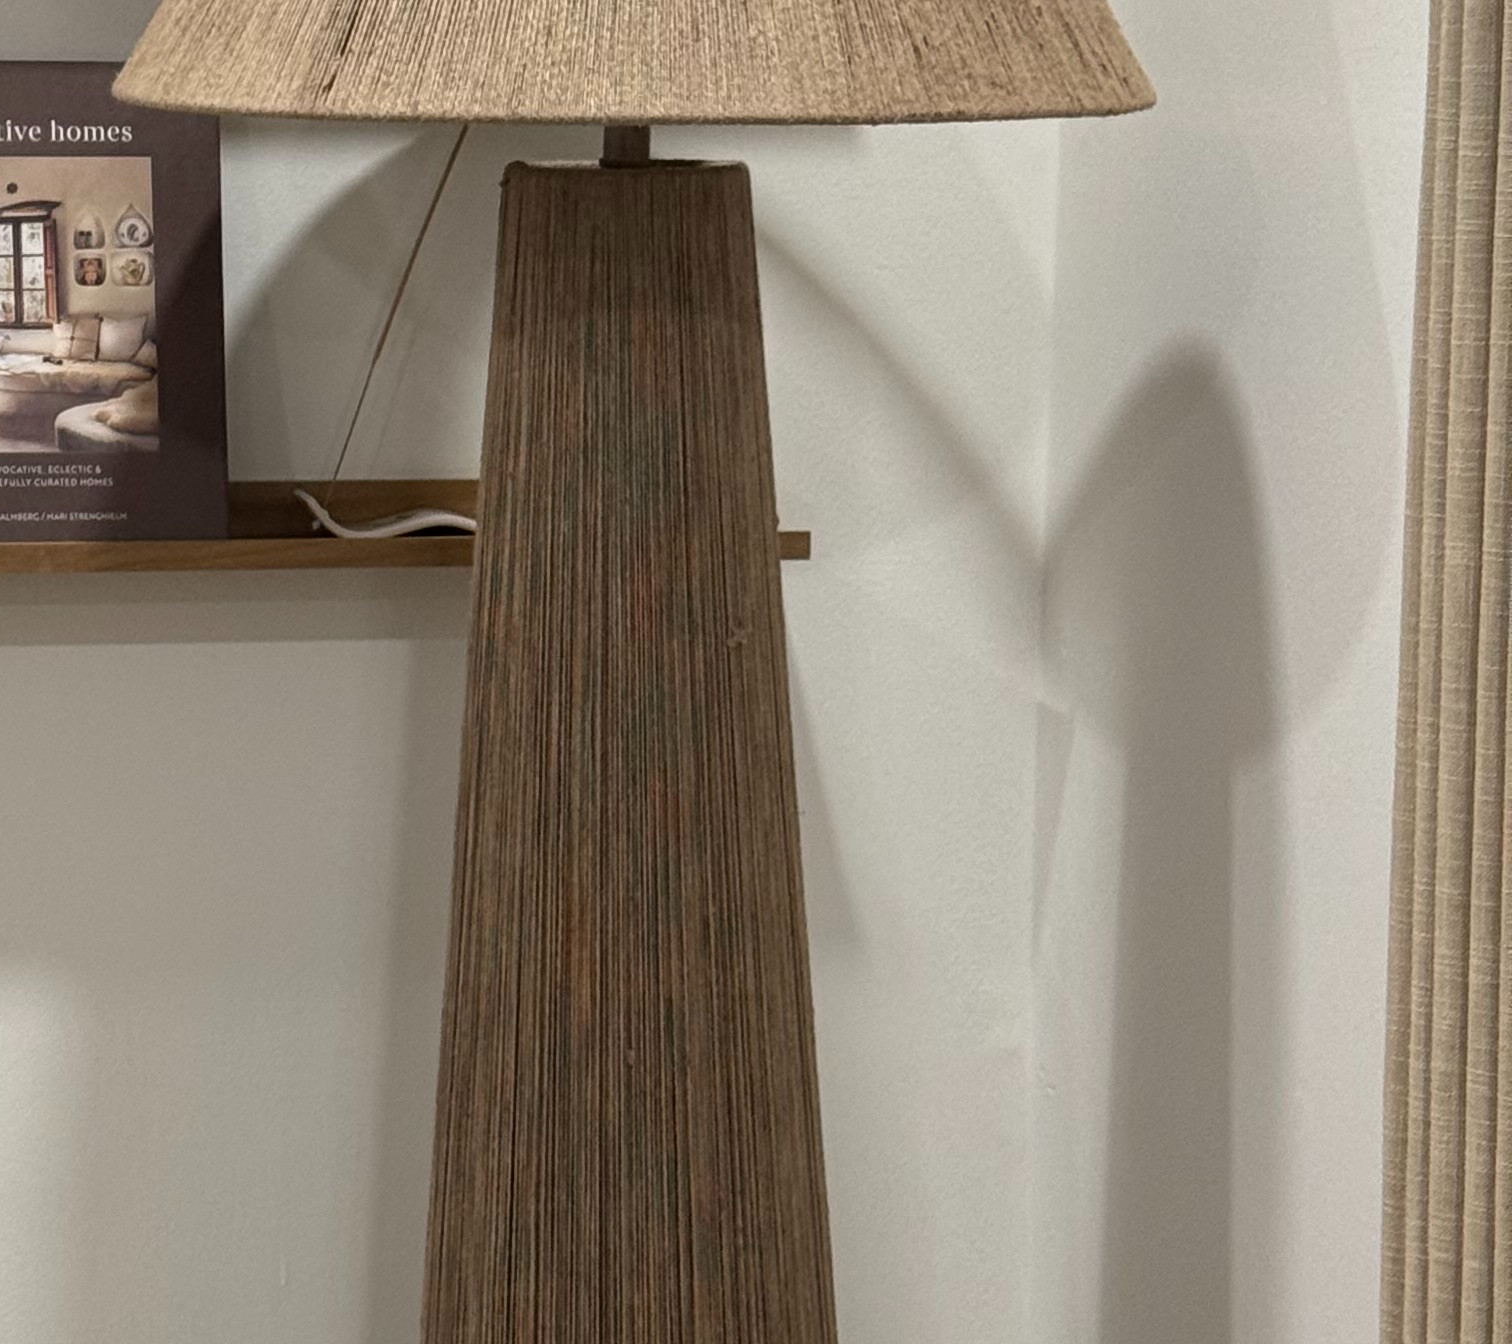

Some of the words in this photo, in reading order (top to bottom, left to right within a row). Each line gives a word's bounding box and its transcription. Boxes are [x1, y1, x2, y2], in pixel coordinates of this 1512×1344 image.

[50, 119, 134, 143] homes
[48, 464, 93, 475] ECLECTIC
[33, 477, 78, 488] CURATED
[79, 477, 114, 488] HOMES
